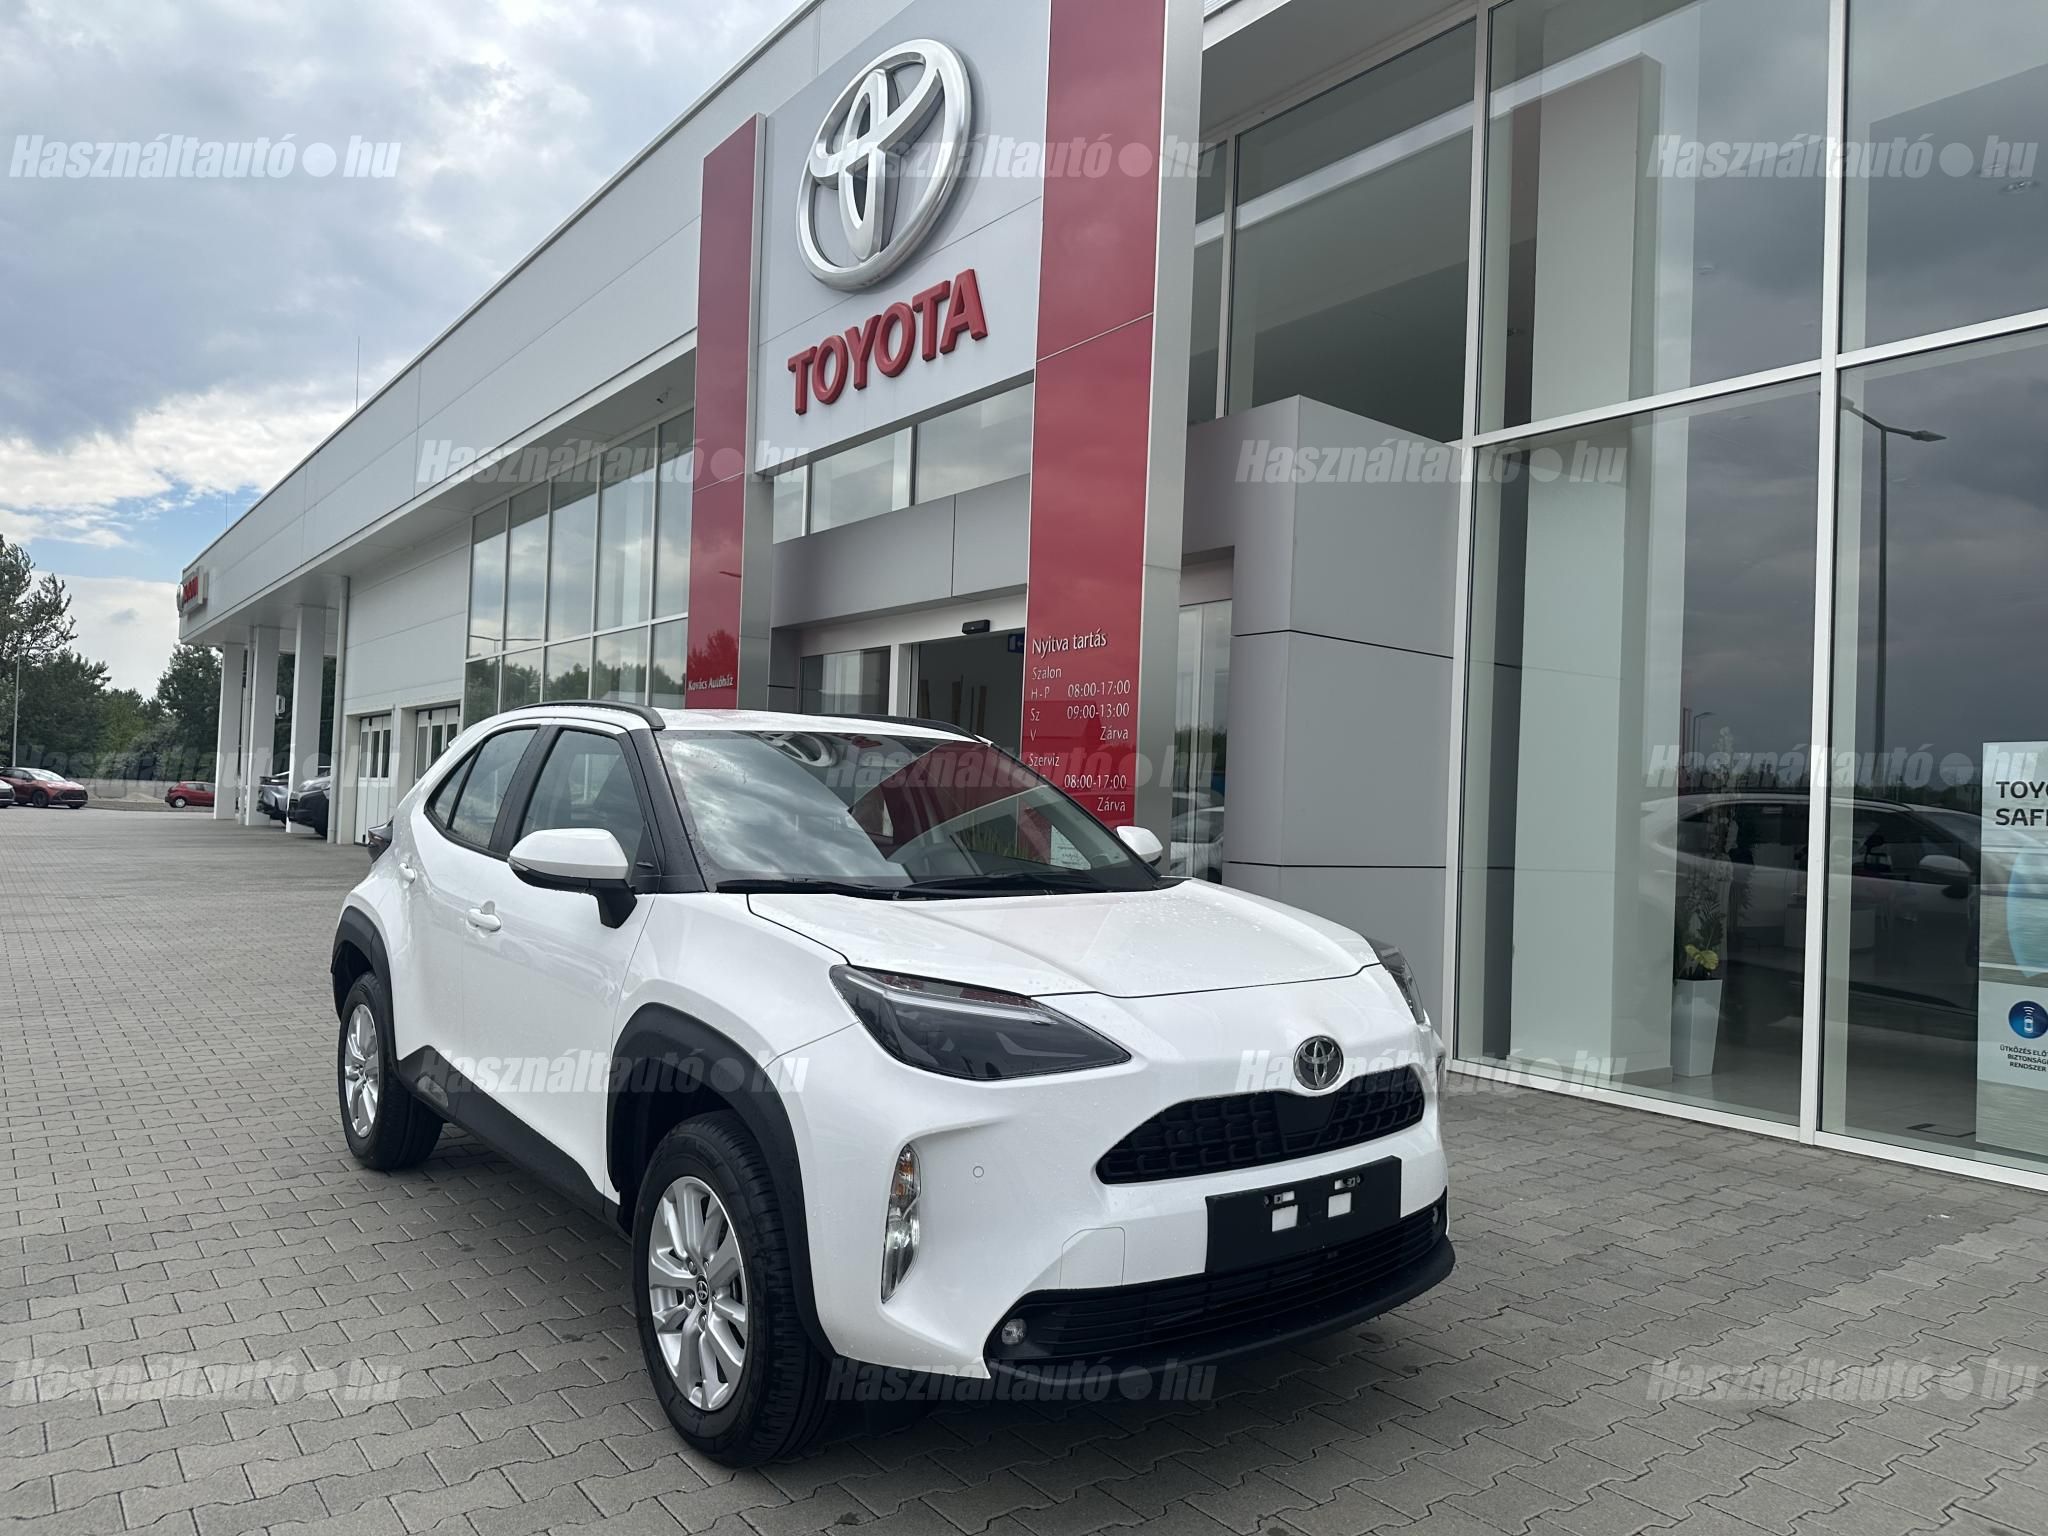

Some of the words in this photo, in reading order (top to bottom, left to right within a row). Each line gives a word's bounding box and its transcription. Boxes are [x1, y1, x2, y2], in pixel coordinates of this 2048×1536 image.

[787, 268, 988, 416] TOYOTA
[1032, 635, 1069, 659] Nyitva
[1072, 628, 1107, 650] tartás
[1032, 666, 1062, 680] Szalon
[688, 678, 707, 691] Kovács
[708, 674, 734, 689] Autóház
[1067, 680, 1131, 698] 08:00-17:00
[1030, 708, 1040, 721] Sz
[1066, 703, 1130, 719] 09:00-13:00
[1030, 729, 1037, 741] V
[1100, 725, 1129, 741] Zárva
[1028, 753, 1060, 767] Szerviz
[1064, 774, 1127, 789] 08:00-17:00
[1995, 781, 2048, 799] TOY
[1097, 796, 1126, 812] Zárva
[1995, 808, 2048, 826] SAF
[2009, 1061, 2046, 1072] RENDSZER
